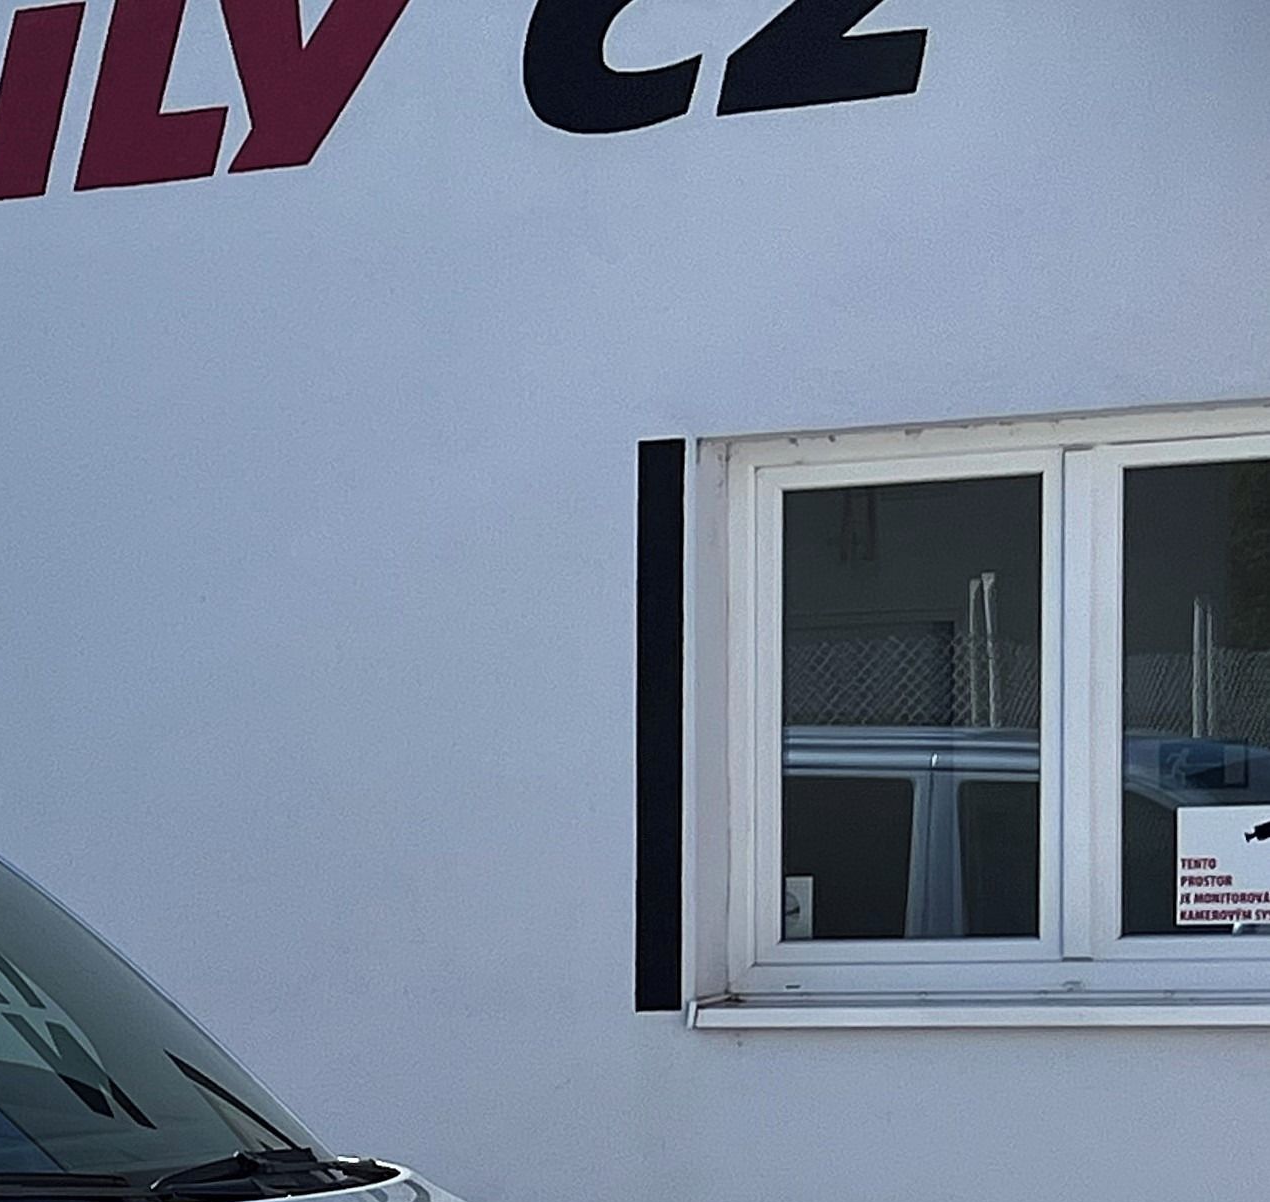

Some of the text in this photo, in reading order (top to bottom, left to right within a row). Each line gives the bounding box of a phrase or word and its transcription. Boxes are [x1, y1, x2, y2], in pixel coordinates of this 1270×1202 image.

[1180, 858, 1217, 870] TENTO
[1180, 875, 1232, 887] PROSTOR
[1180, 893, 1191, 904] JE
